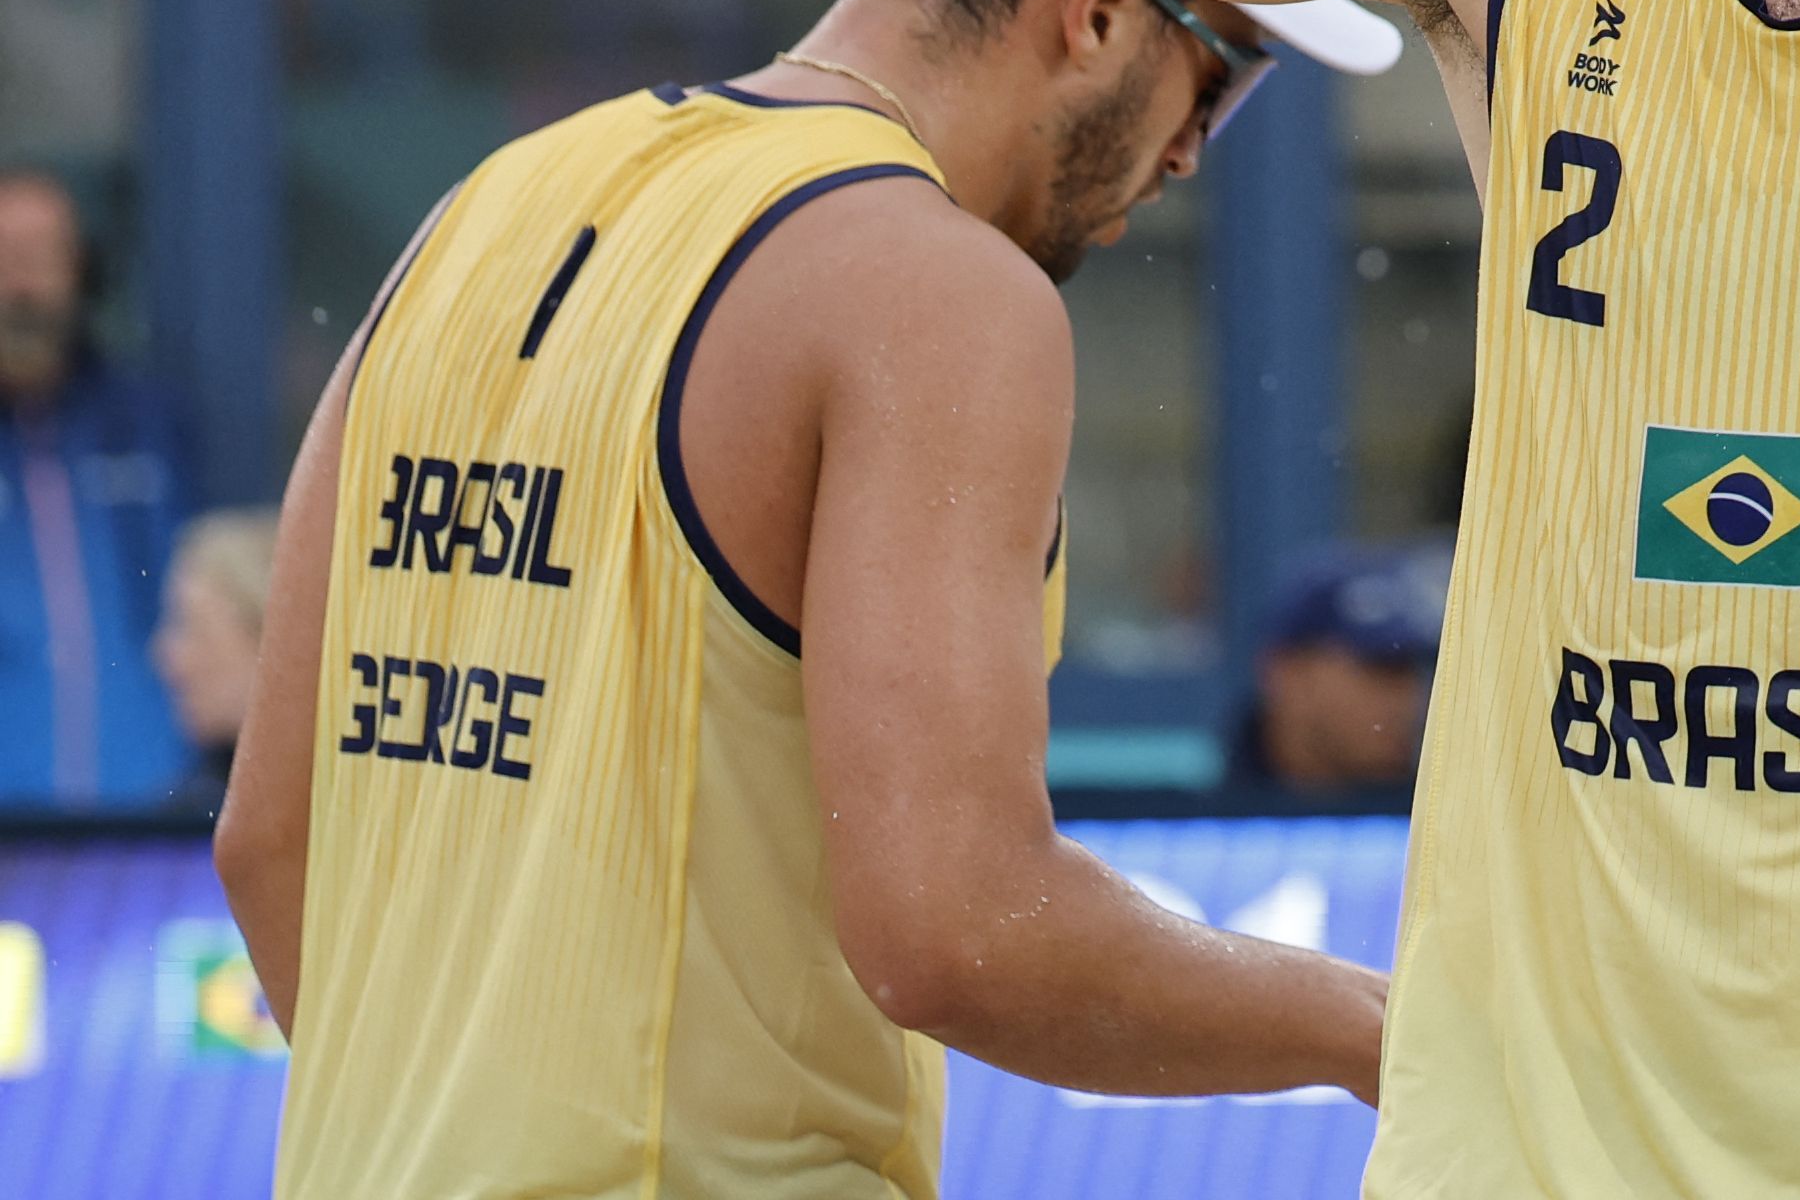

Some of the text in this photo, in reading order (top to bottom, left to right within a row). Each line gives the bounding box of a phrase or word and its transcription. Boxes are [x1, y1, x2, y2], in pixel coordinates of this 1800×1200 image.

[1567, 70, 1617, 96] WORK
[1574, 53, 1620, 76] BODY
[519, 224, 597, 360] 1
[1526, 129, 1623, 328] 2
[369, 454, 573, 588] BRASIL
